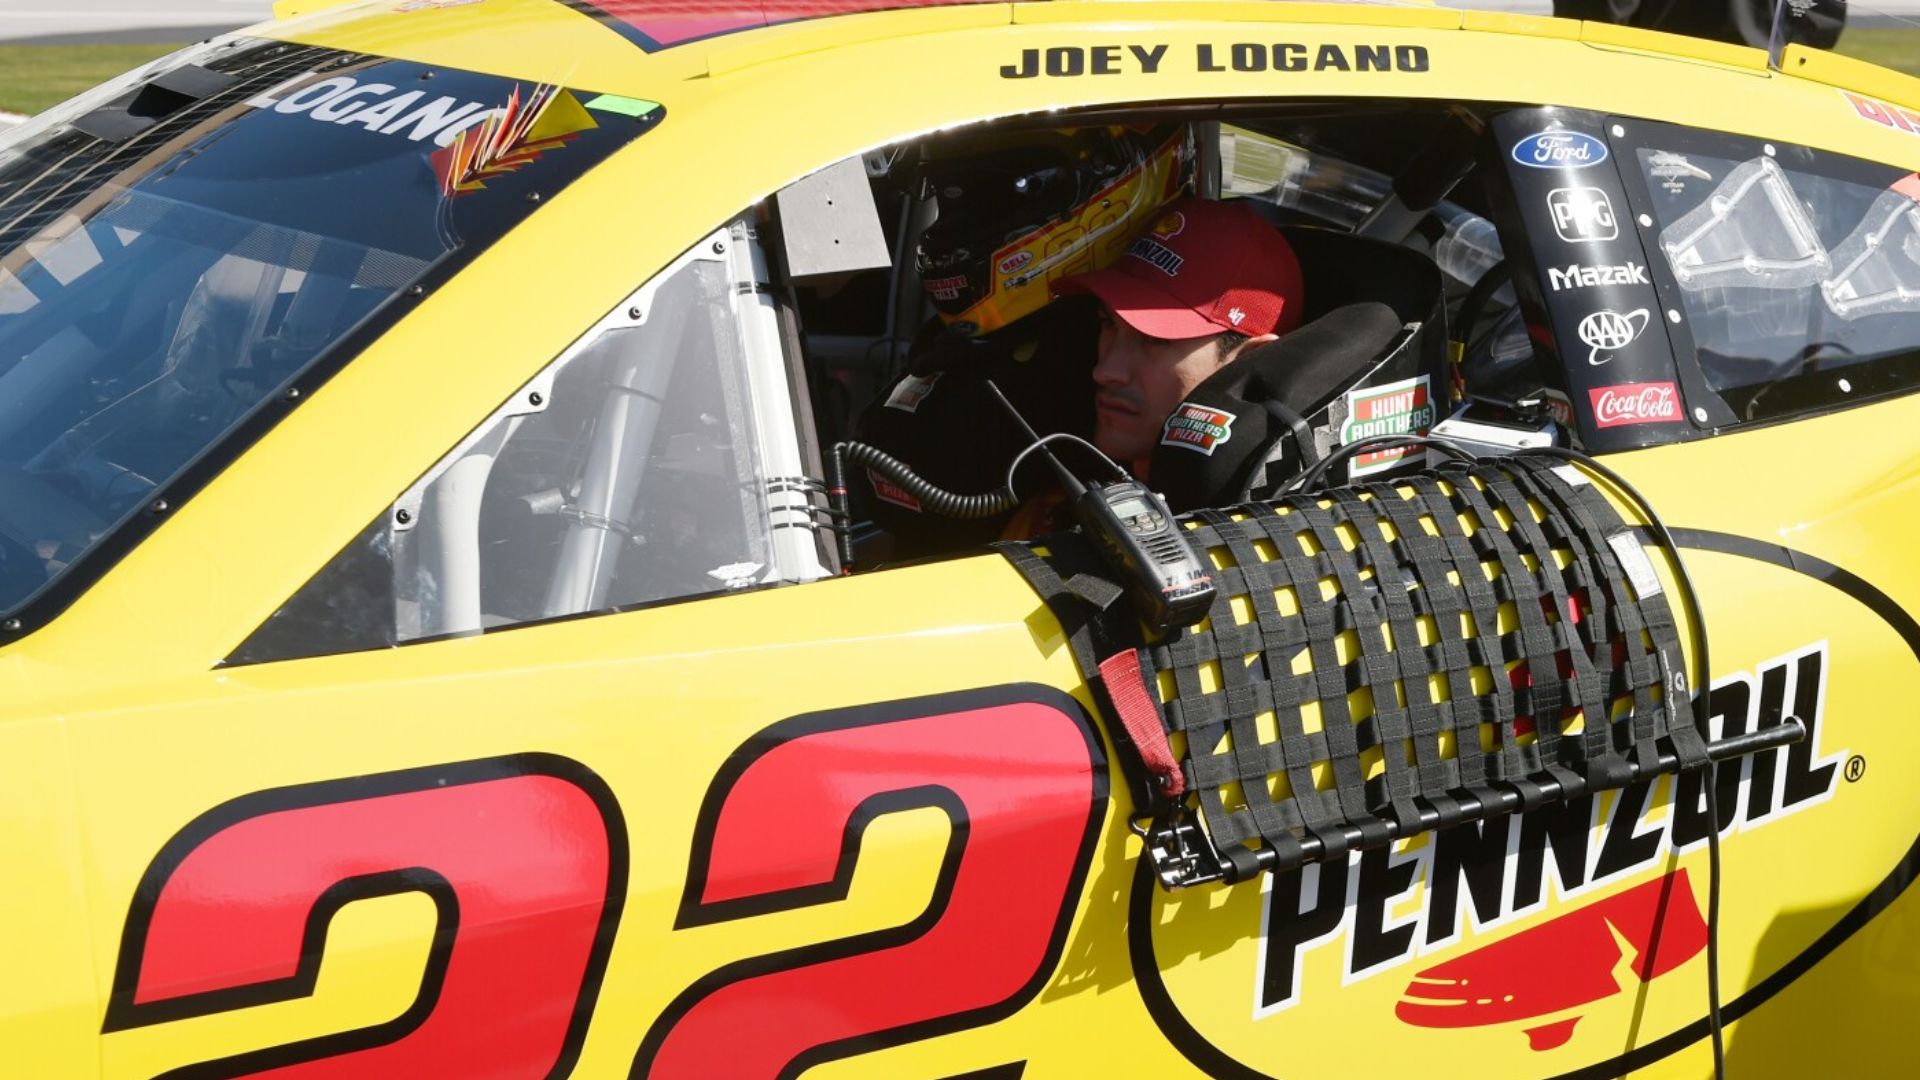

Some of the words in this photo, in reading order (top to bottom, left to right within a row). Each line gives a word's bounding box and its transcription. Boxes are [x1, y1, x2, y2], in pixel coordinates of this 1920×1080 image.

[1000, 44, 1170, 79] JOEY
[1196, 43, 1430, 73] LOGANO
[1534, 136, 1591, 162] Ford
[1548, 262, 1649, 291] Mazak
[1585, 313, 1629, 347] AAA
[1186, 408, 1215, 423] HUNT
[1371, 391, 1415, 420] HUNT
[1597, 387, 1673, 422] Coca-Cola
[1170, 416, 1221, 438] BROTHERS
[1351, 407, 1430, 441] BROTHERS
[1260, 648, 1840, 1010] PENNZOIL
[102, 682, 1109, 1080] 22
